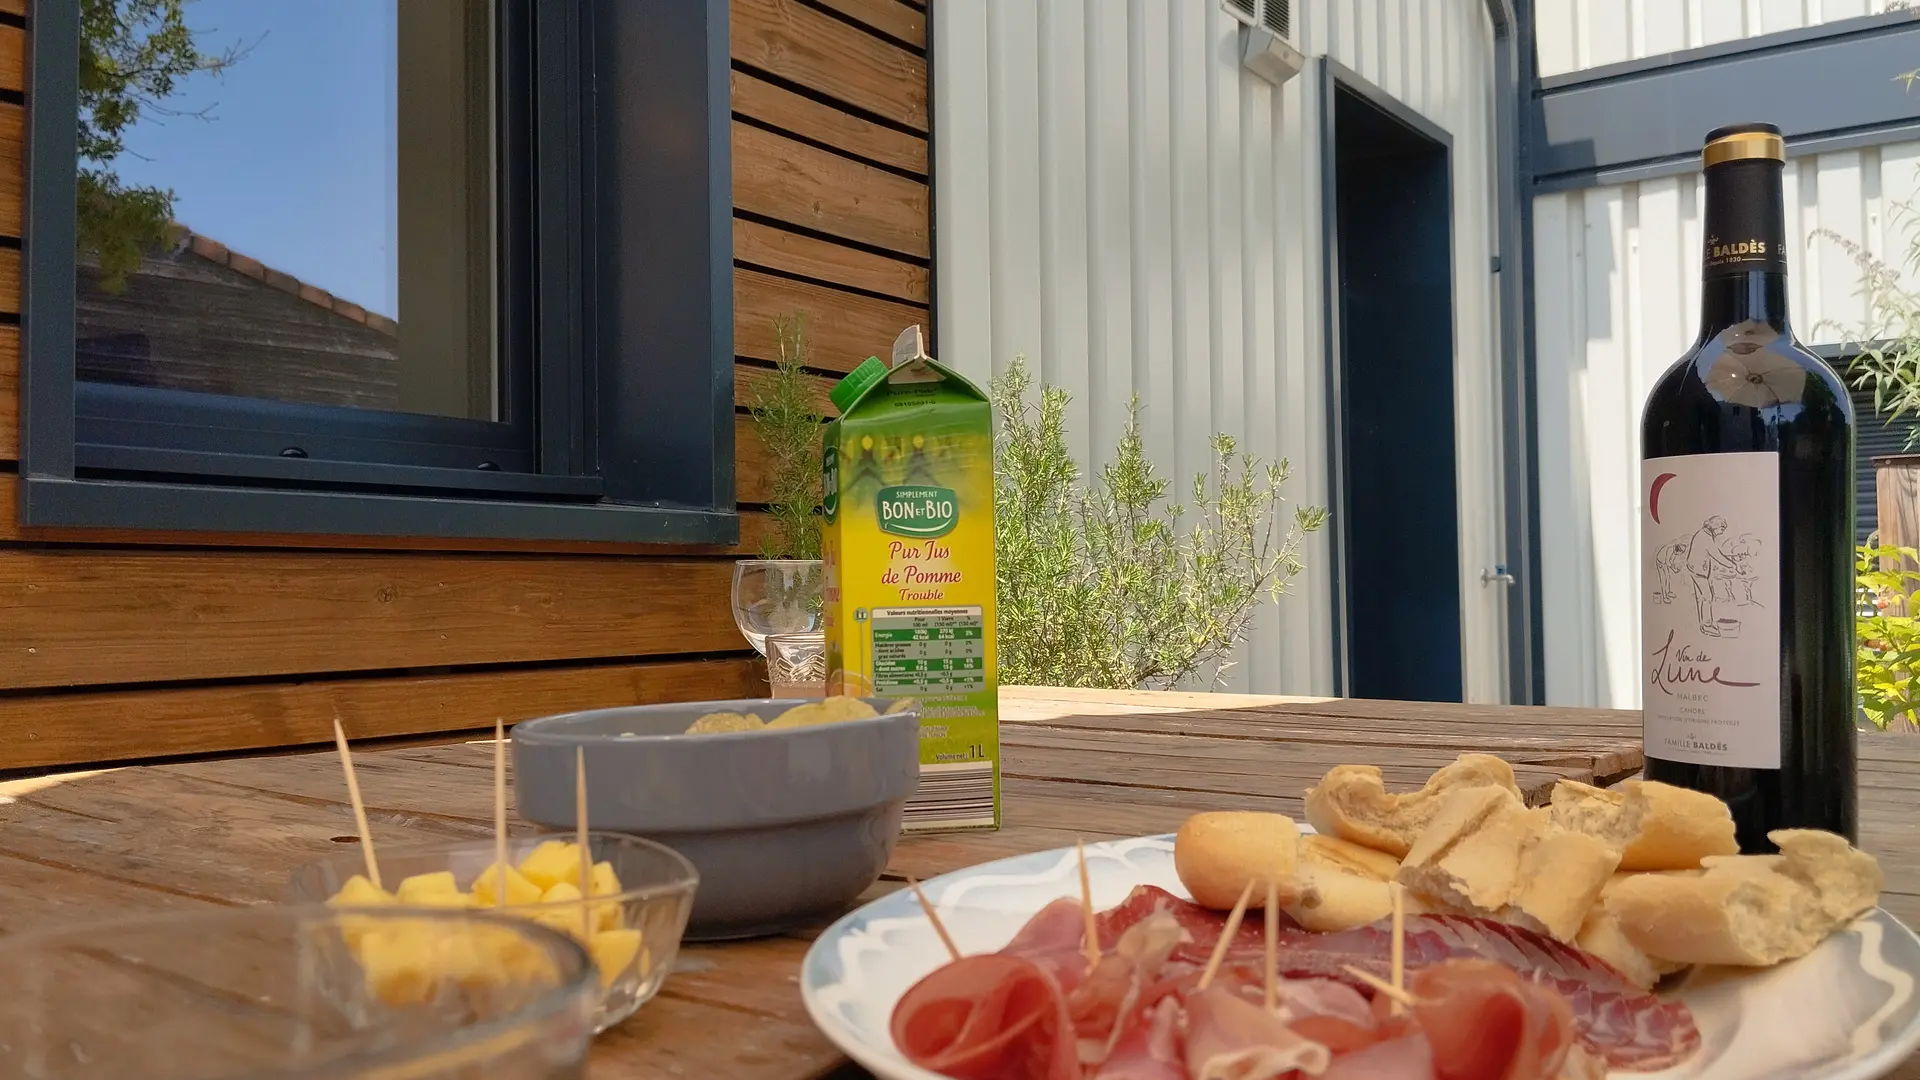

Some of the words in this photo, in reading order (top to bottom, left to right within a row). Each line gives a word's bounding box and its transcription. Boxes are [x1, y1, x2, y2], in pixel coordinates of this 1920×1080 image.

[1713, 238, 1766, 257] BALDÈS
[896, 490, 938, 500] SIMPLEMENT
[882, 500, 917, 520] BON
[925, 500, 953, 519] BIO
[888, 541, 921, 560] Pur
[924, 540, 950, 561] Jus
[881, 567, 900, 584] de
[904, 565, 962, 584] Pomme
[898, 588, 944, 601] Trouble
[1651, 628, 1761, 696] Lune
[1675, 644, 1694, 663] Vin
[1696, 650, 1712, 663] de
[1676, 693, 1709, 703] MALBEC
[1679, 706, 1706, 715] CAHORS
[1664, 738, 1691, 748] FAMILLE
